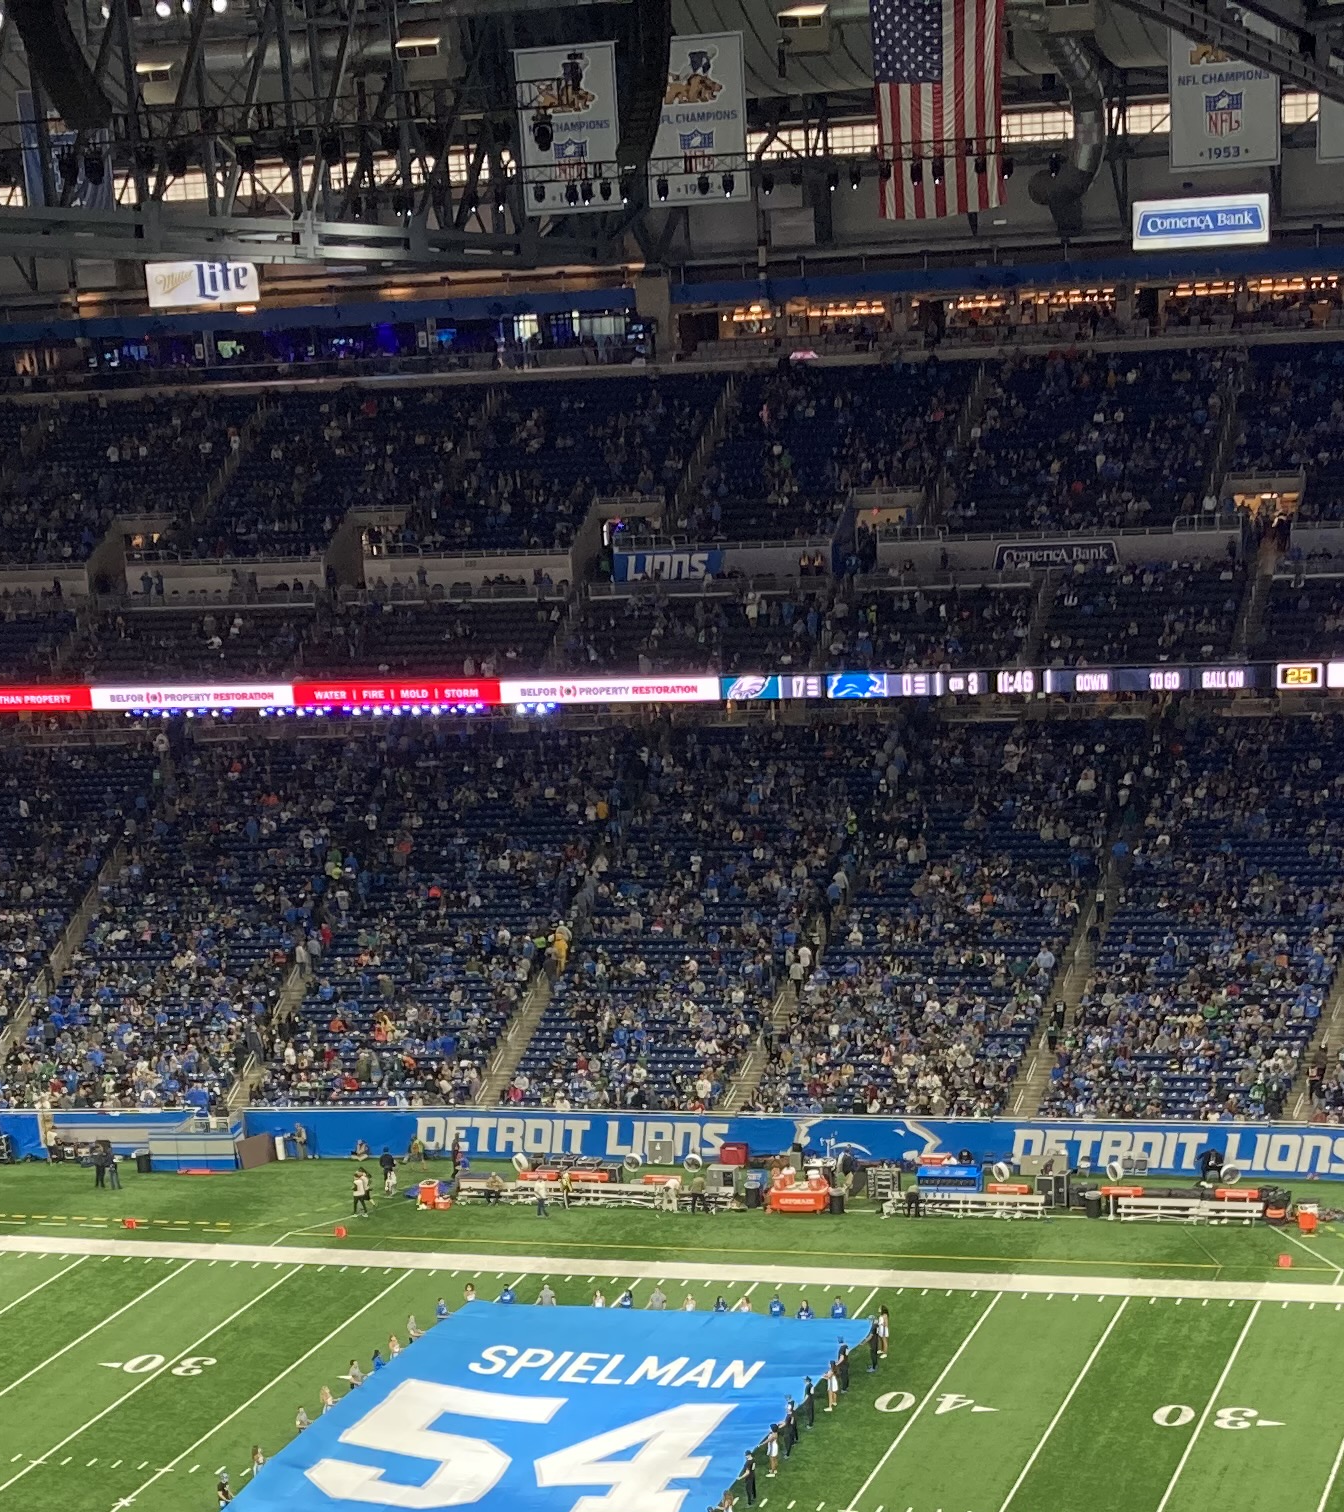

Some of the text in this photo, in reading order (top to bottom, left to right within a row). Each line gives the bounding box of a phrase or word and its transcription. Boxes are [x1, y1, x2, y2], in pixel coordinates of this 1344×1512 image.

[1177, 76, 1200, 86] NFL
[675, 110, 738, 124] CHAMPIONS
[1208, 111, 1242, 136] NFL
[1206, 146, 1240, 160] 1953
[1216, 209, 1254, 228] Bank
[194, 261, 248, 301] Lite
[1072, 546, 1108, 562] Bank
[626, 552, 709, 582] LIONS
[966, 673, 979, 695] 3
[996, 670, 1034, 695] 11:46
[1074, 672, 1109, 692] DOWN
[1149, 670, 1162, 690] TO
[1201, 670, 1228, 690] BALL
[1284, 666, 1312, 686] 25
[23, 694, 72, 705] PROPERTY
[313, 686, 479, 700] WATER FIRE MOLD STORM
[519, 684, 699, 698] BELFOR PROPERTY RESTORATION
[416, 1116, 730, 1158] DETROIT LIONS
[1011, 1128, 1210, 1170] DETROIT
[121, 1353, 218, 1378] 30
[467, 1344, 766, 1389] SPIELMAN
[873, 1390, 975, 1416] 40
[1151, 1404, 1260, 1430] 30
